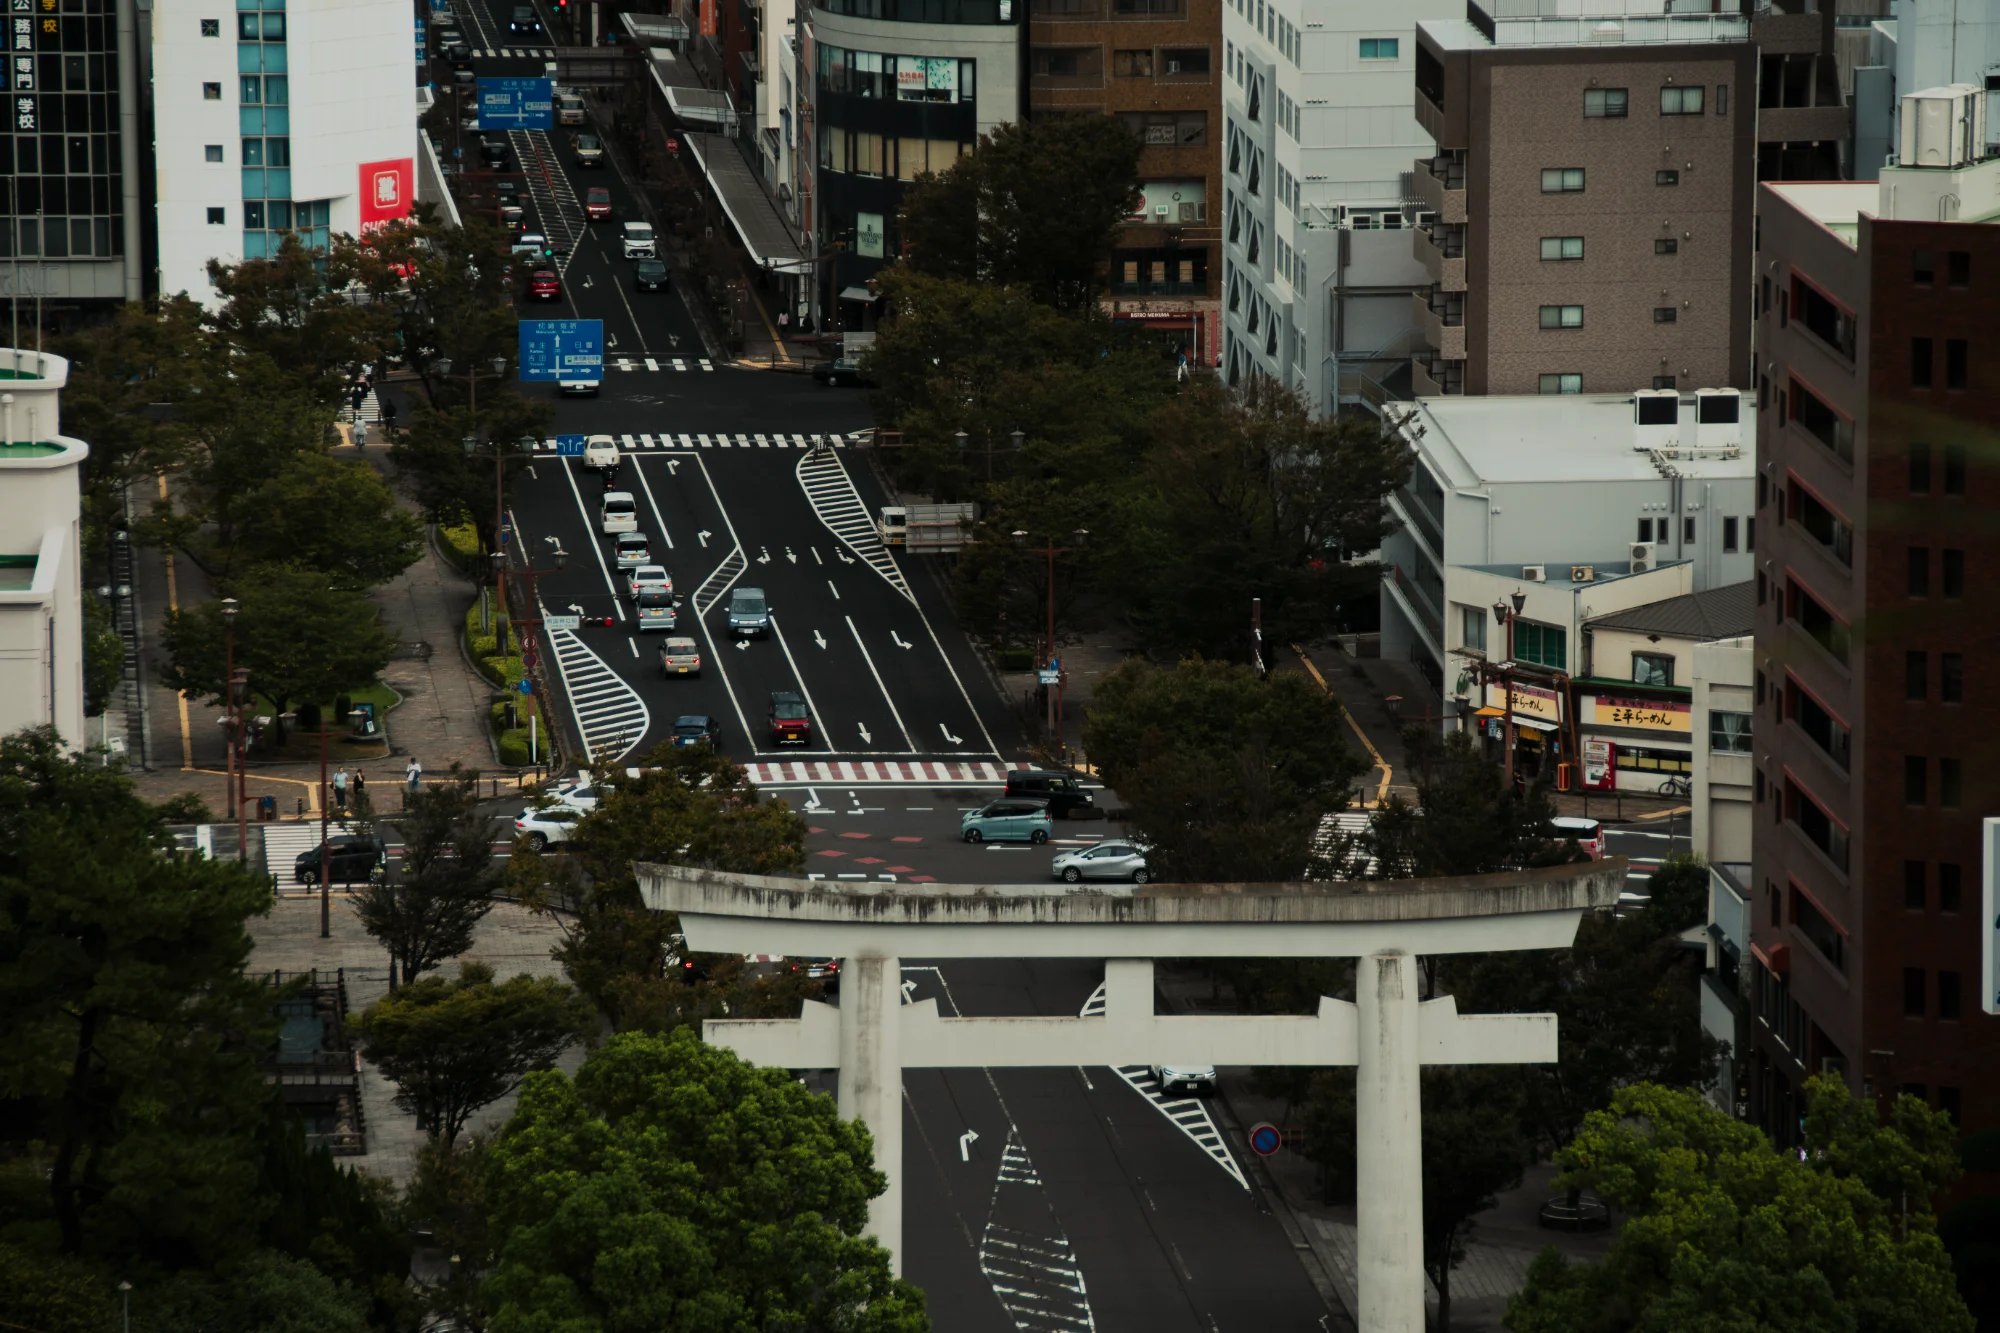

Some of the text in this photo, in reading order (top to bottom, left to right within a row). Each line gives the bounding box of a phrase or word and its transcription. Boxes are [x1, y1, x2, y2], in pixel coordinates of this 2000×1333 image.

[14, 0, 36, 129] 公務員専門学校
[1505, 693, 1544, 712] 平らーめん
[1612, 708, 1672, 726] 三平らーめん
